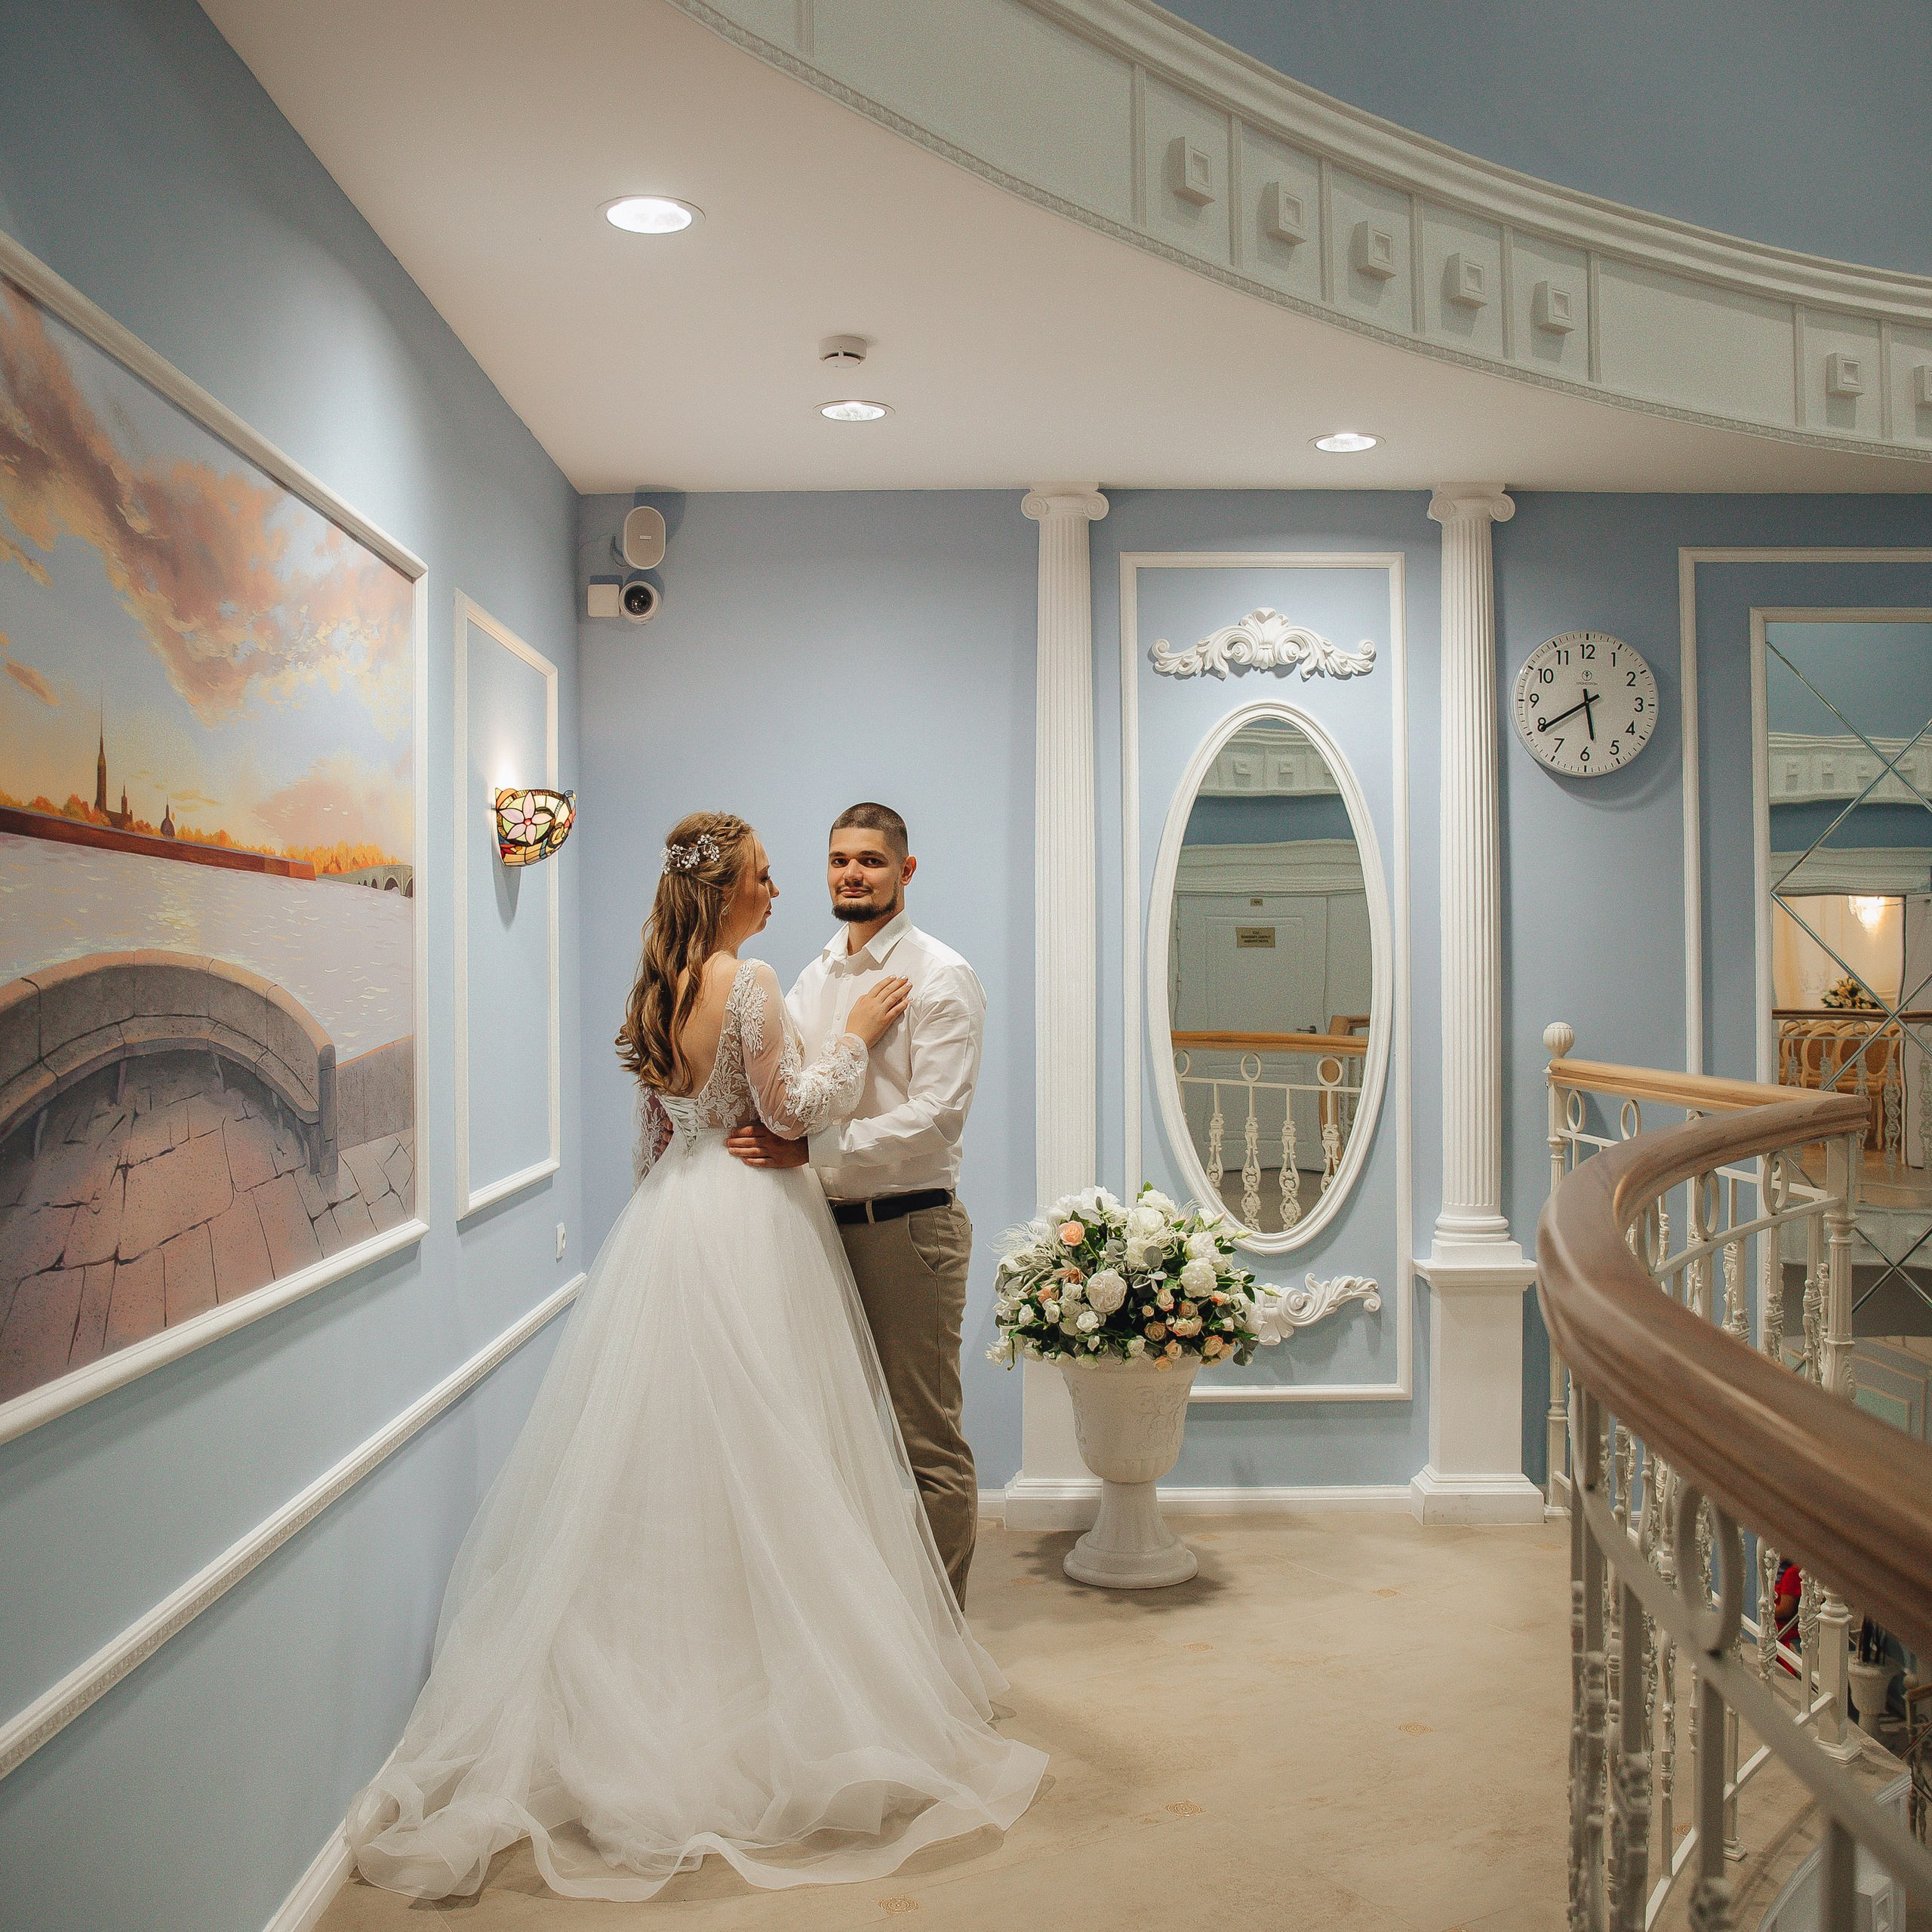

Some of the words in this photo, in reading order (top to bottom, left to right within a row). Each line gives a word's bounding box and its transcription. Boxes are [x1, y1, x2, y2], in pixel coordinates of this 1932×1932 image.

[1555, 650, 1569, 666] 11
[1580, 644, 1595, 660] 12
[1611, 651, 1617, 667] 1
[1537, 668, 1554, 684] 10
[1626, 671, 1636, 687] 2
[1529, 693, 1540, 709] 9
[1634, 697, 1644, 713] 3
[1537, 717, 1546, 732] 8
[1625, 720, 1635, 736] 4
[1554, 737, 1565, 753] 7
[1609, 740, 1620, 755] 5
[1580, 746, 1590, 761] 6
